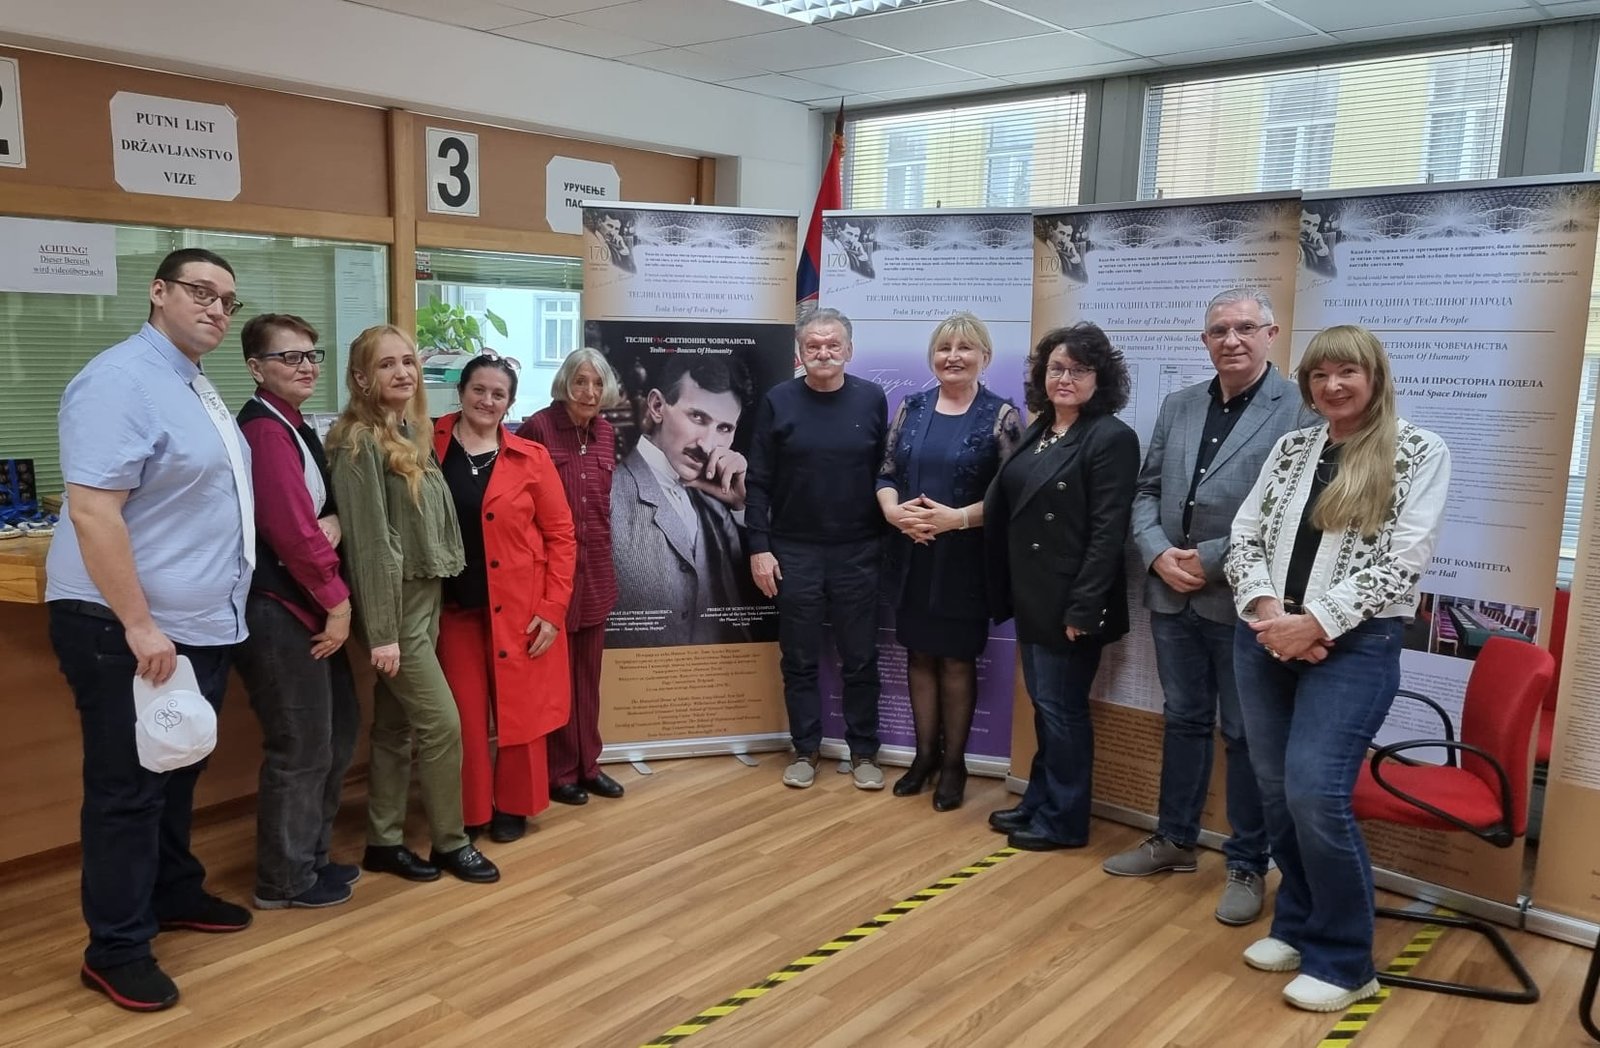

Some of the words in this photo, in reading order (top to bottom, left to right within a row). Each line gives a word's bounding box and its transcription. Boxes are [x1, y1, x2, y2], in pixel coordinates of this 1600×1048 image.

[136, 112, 178, 129] PUTNI
[186, 119, 215, 133] LIST
[121, 139, 233, 162] DRŽAVLJANSTVO
[436, 137, 471, 207] 3
[163, 171, 197, 186] VIZE
[563, 182, 606, 196] УРУЧЕЊЕ
[565, 198, 583, 209] ПАС
[39, 244, 88, 255] ACHTUNG!
[590, 246, 609, 261] 170
[40, 255, 63, 264] Dieser
[64, 256, 90, 266] Bereich
[827, 253, 847, 268] 170
[1040, 256, 1059, 272] 170
[33, 266, 50, 275] wird
[1079, 301, 1113, 310] ТЕСЛИНА
[1116, 301, 1149, 310] ГОДИНА
[1151, 300, 1193, 309] ТЕСЛИНОГ
[1323, 299, 1368, 308] ТЕСЛИНА
[1371, 299, 1411, 307] ГОДИНА
[1413, 297, 1467, 307] ТЕСЛИНОГ
[1470, 296, 1514, 307] НАРОДА
[1107, 317, 1125, 325] Tesla
[1127, 317, 1142, 325] Year
[1144, 317, 1152, 326] of
[1153, 317, 1171, 325] Tesla
[1173, 317, 1196, 326] People
[1359, 316, 1380, 324] Tesla
[1383, 316, 1402, 324] Year
[1403, 316, 1414, 326] of
[1415, 315, 1437, 324] Tesla
[1441, 315, 1470, 326] People
[697, 347, 705, 355] Of
[1434, 341, 1509, 351] ЧОВЕЧАНСТВА
[1416, 352, 1428, 362] Of
[1428, 352, 1470, 362] Humanity
[1422, 376, 1430, 385] И
[1431, 377, 1496, 387] ПРОСТОРНА
[1498, 378, 1544, 388] ПОДЕЛА
[1407, 388, 1425, 397] And
[1427, 389, 1450, 399] Space
[1452, 389, 1488, 399] Division
[1454, 558, 1512, 573] КОМИТЕТА
[1438, 569, 1458, 579] Hall
